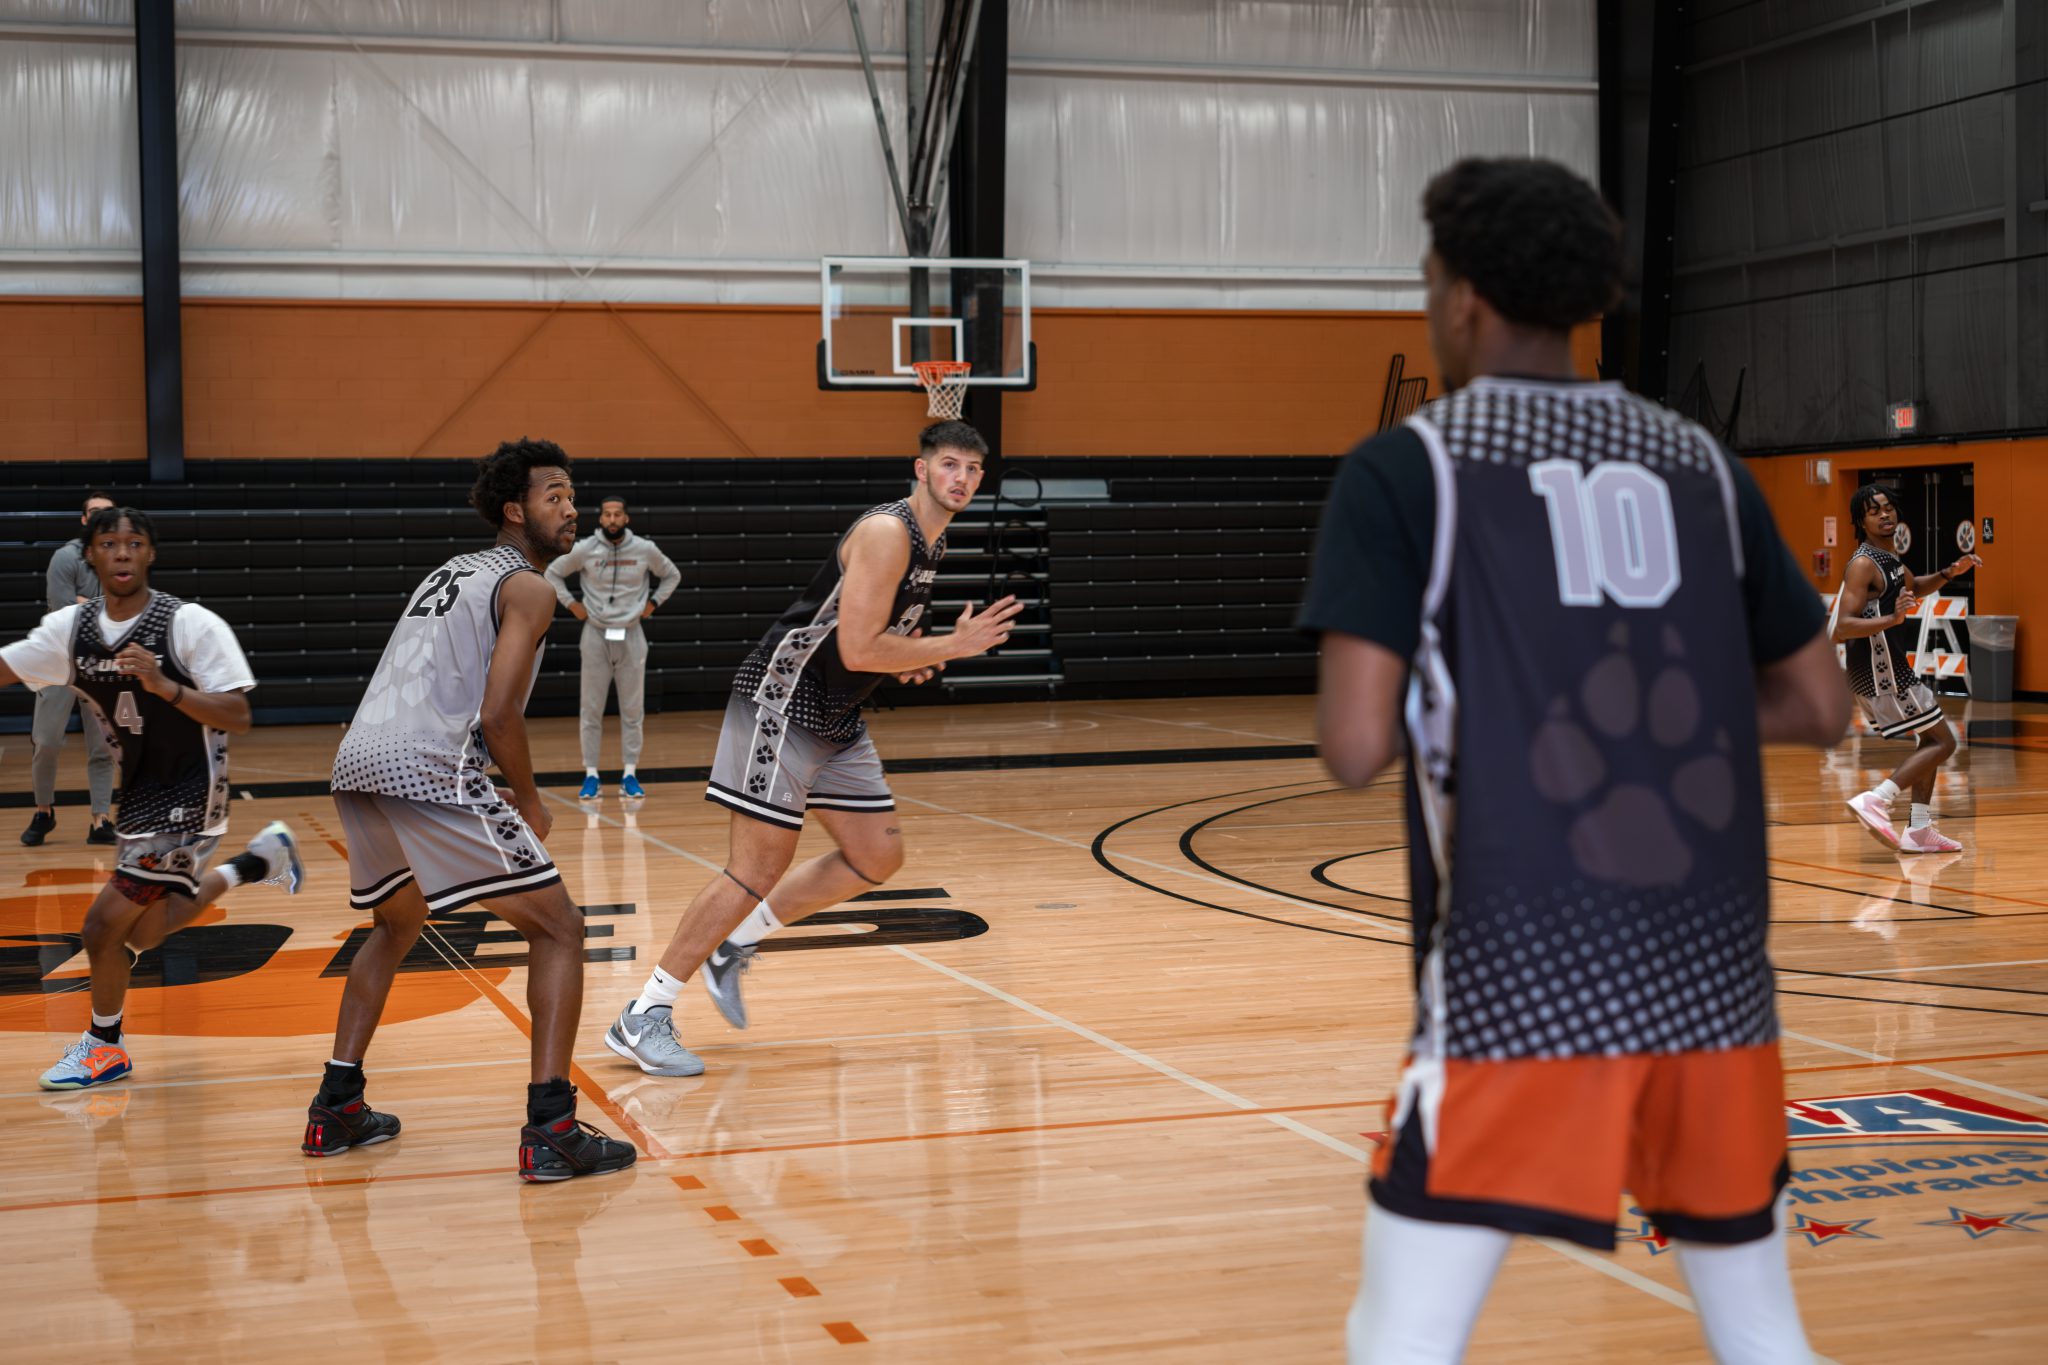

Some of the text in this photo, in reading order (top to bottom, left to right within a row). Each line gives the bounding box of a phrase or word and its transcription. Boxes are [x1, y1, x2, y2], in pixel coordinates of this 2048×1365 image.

[1528, 458, 1682, 608] 10
[405, 568, 479, 618] 25
[114, 691, 143, 734] 4
[1786, 1167, 2048, 1205] haract
